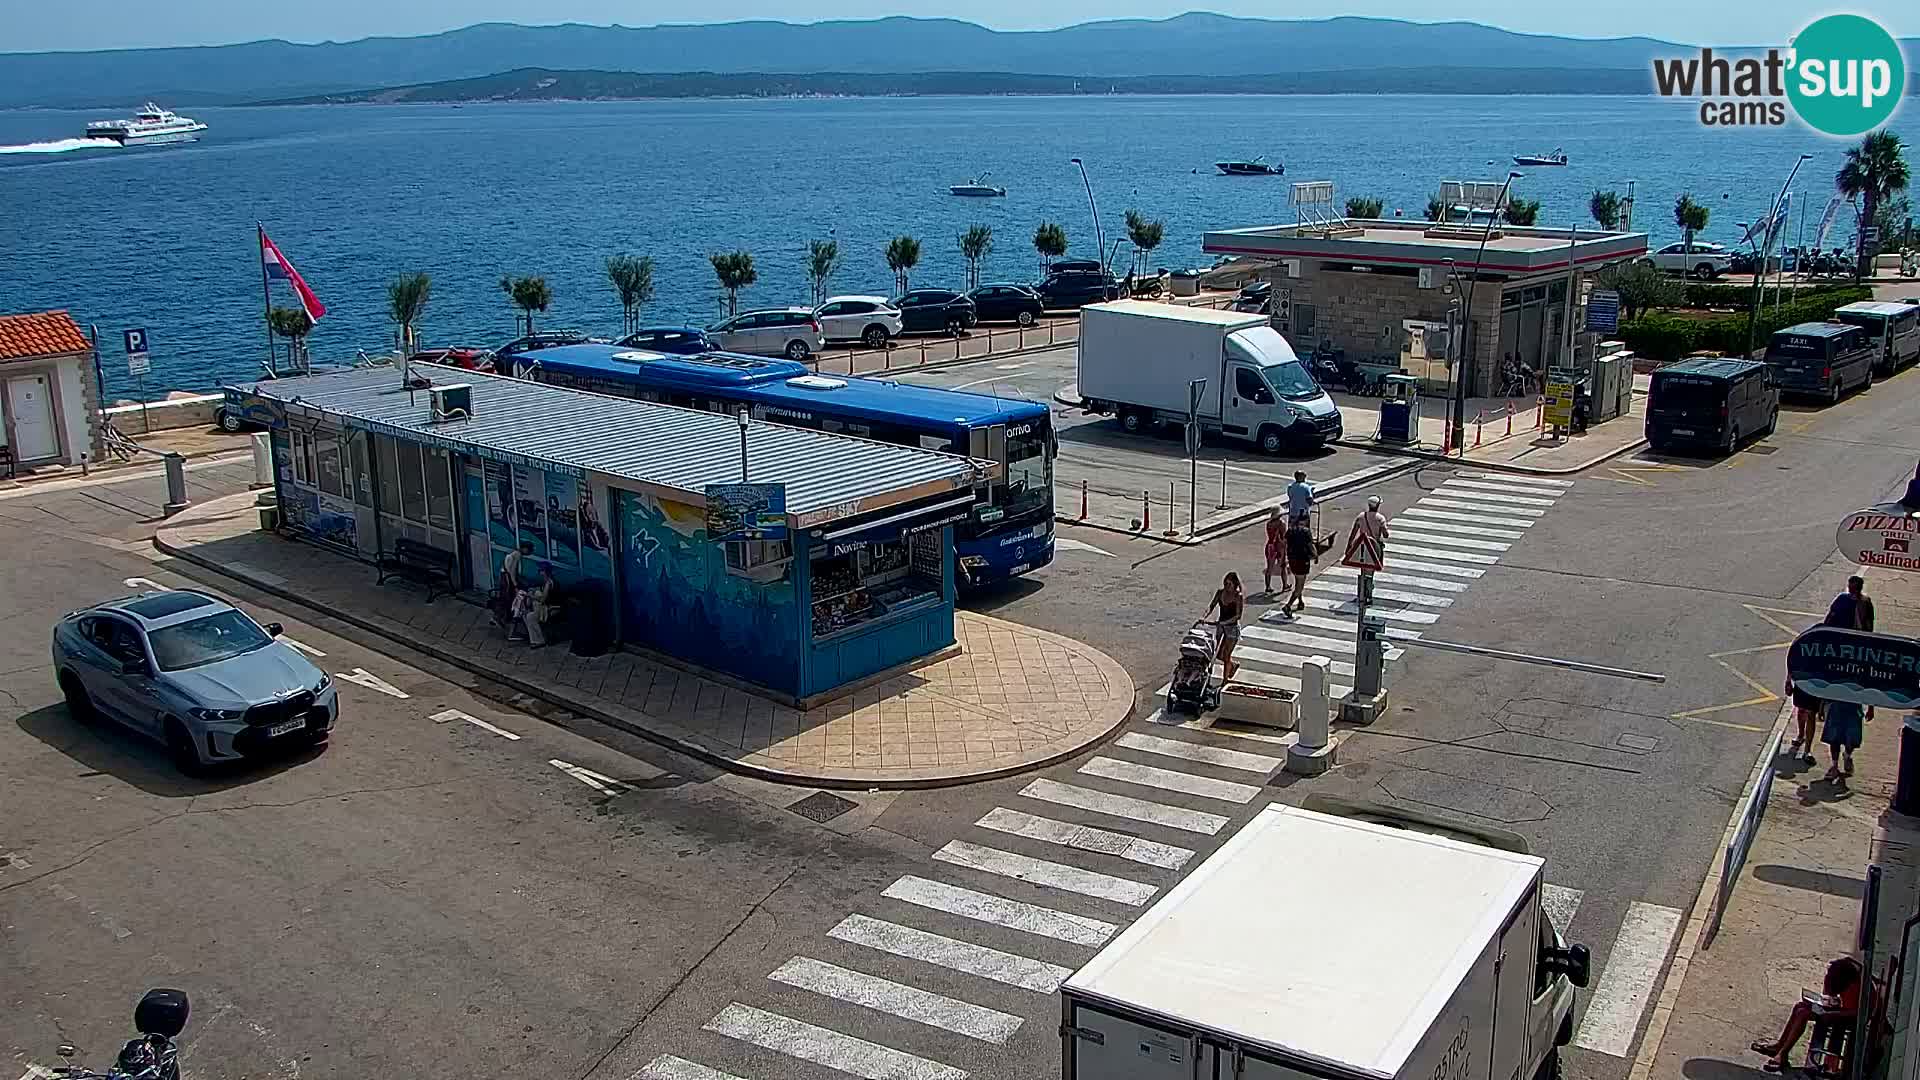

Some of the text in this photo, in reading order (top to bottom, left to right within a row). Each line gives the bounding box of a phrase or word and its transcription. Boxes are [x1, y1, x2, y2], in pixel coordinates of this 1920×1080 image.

[129, 332, 141, 350] P
[1790, 337, 1807, 345] TAXI
[1006, 424, 1030, 437] arriva
[493, 450, 525, 465] STATION
[528, 458, 552, 473] TICKET
[554, 463, 582, 478] OFFICE
[1881, 531, 1915, 541] GRILL
[1826, 662, 1896, 680] caffe bar
